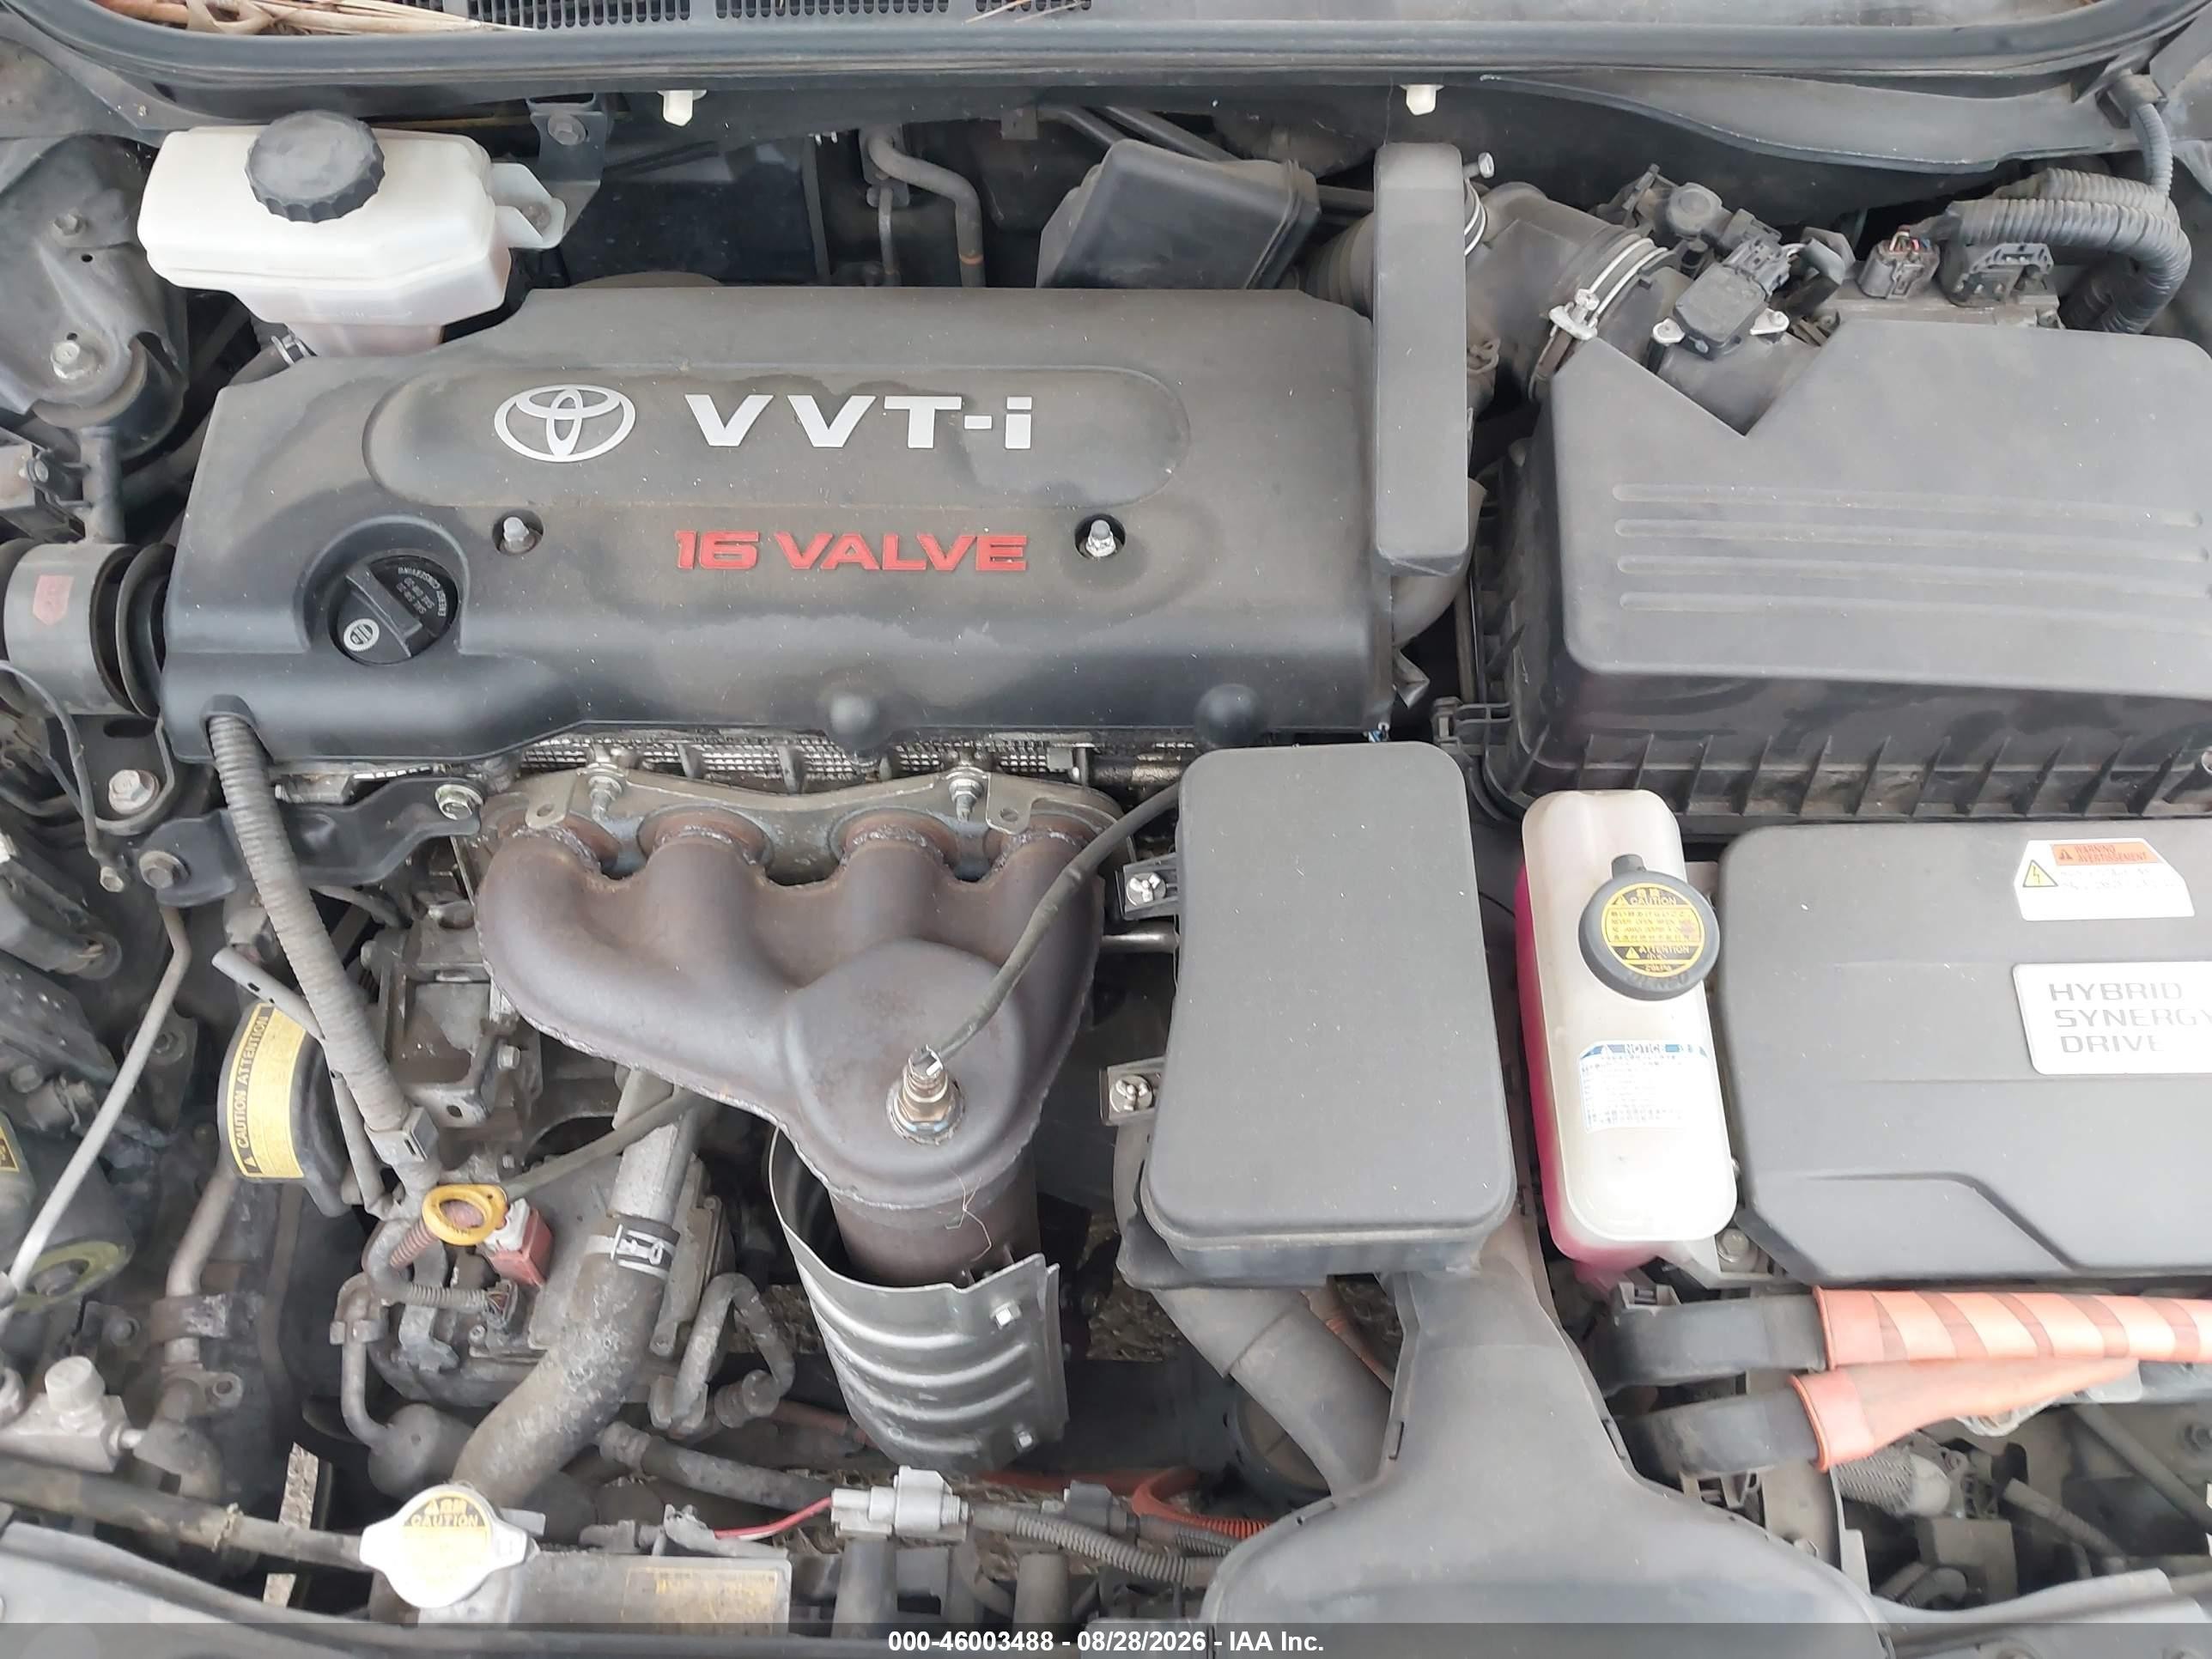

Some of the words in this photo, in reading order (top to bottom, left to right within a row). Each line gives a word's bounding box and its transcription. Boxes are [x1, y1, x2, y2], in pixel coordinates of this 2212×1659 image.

[684, 394, 1032, 450] VVT-i
[674, 531, 760, 570] 16
[775, 532, 1028, 572] VALVE
[1630, 896, 1677, 906] CAUTION
[1638, 945, 1691, 955] ATTENTION
[2049, 982, 2182, 1001] HYBRID
[237, 1016, 268, 1085] ATTENTION
[2061, 1035, 2164, 1053] DRIVE
[233, 1091, 249, 1149] CAUTION
[410, 1514, 478, 1527] CAUTION
